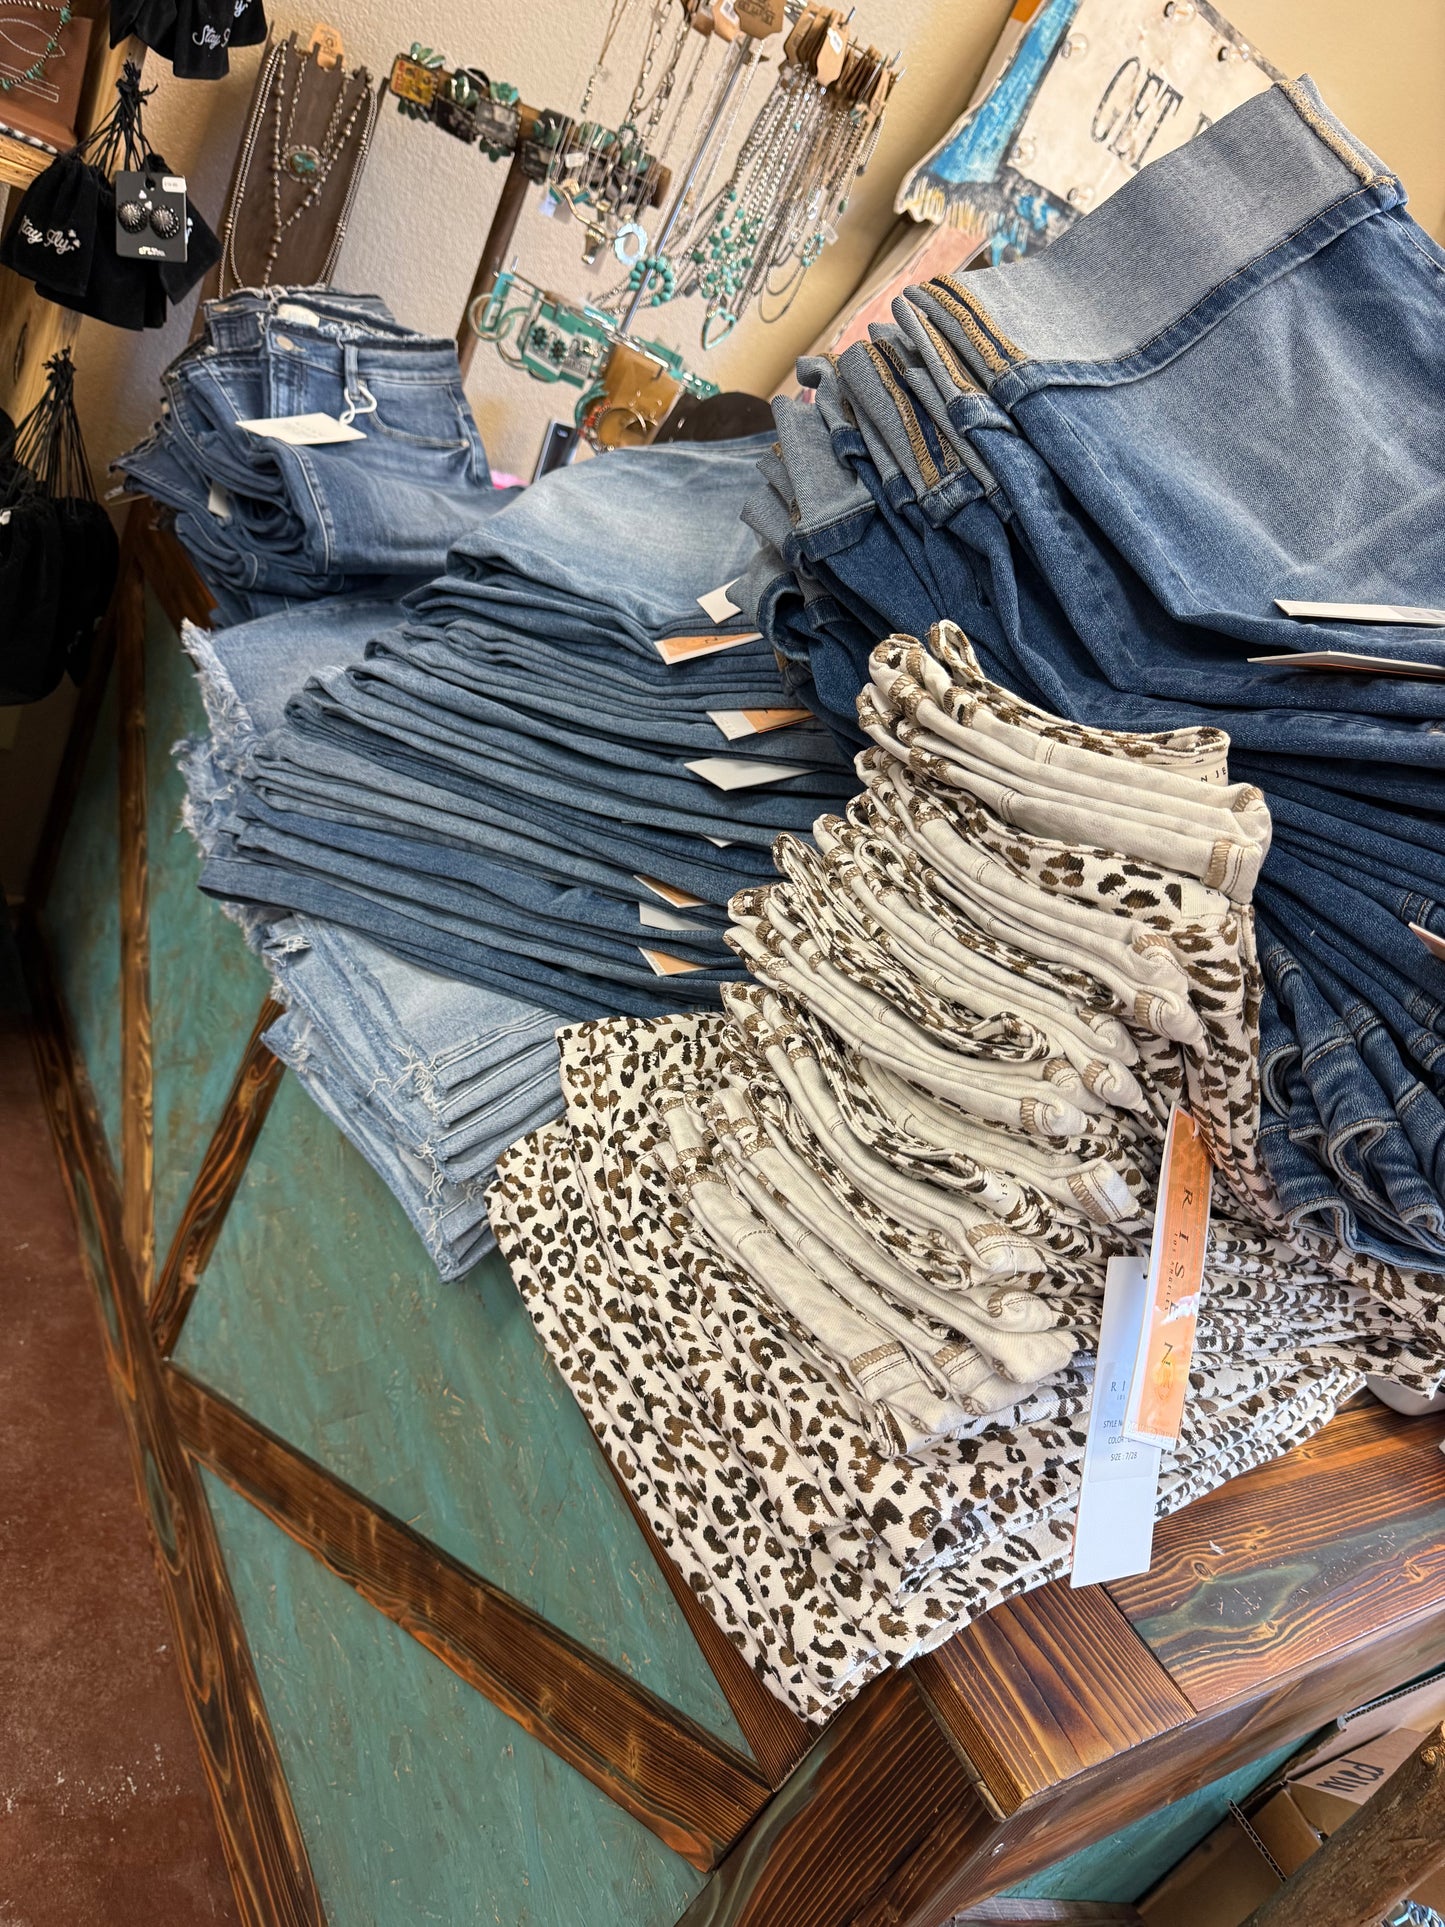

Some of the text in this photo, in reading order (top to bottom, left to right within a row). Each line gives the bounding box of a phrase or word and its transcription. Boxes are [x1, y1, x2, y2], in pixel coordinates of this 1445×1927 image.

[192, 24, 221, 50] Stay
[1091, 56, 1184, 171] GET
[1103, 1420, 1117, 1428] STYLE
